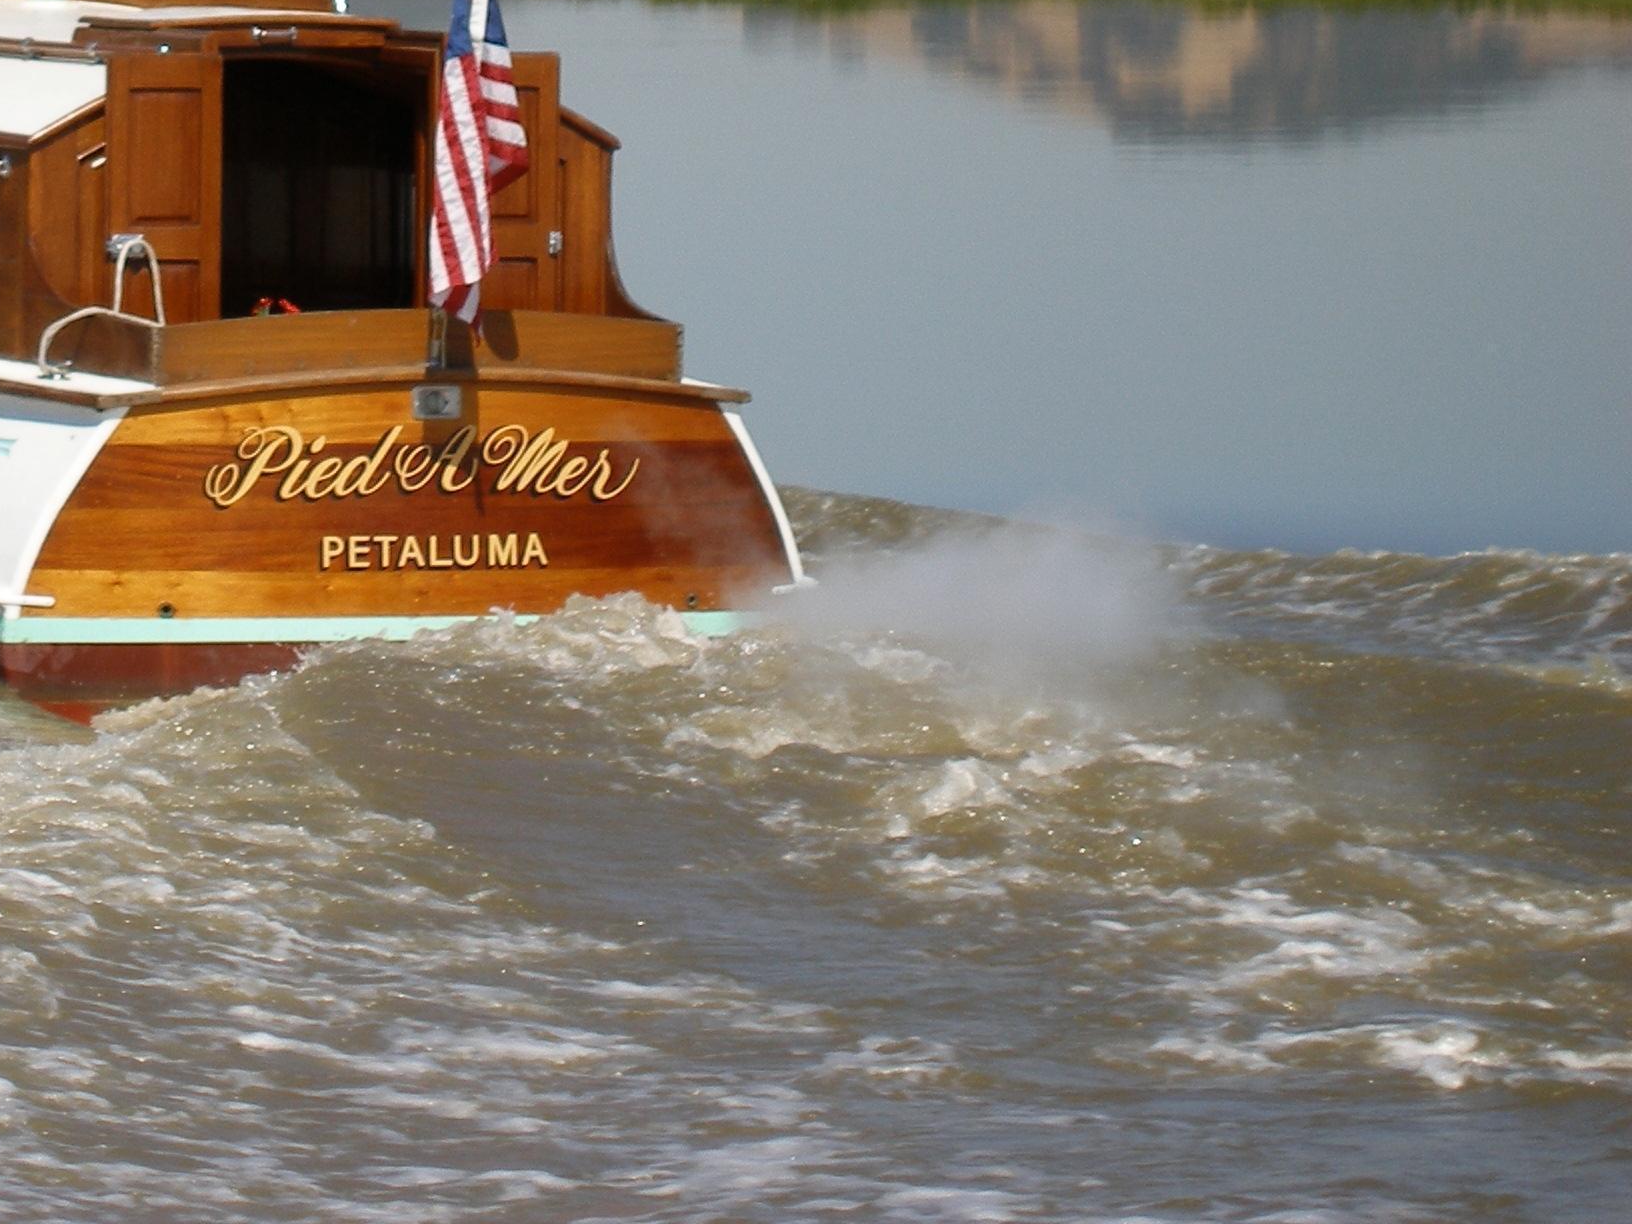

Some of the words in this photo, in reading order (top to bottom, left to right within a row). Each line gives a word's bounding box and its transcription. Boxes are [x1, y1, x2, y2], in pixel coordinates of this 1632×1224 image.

[206, 425, 402, 506] Pied
[395, 424, 478, 492] A
[482, 424, 640, 501] Mer
[322, 532, 548, 569] PETALUMA
